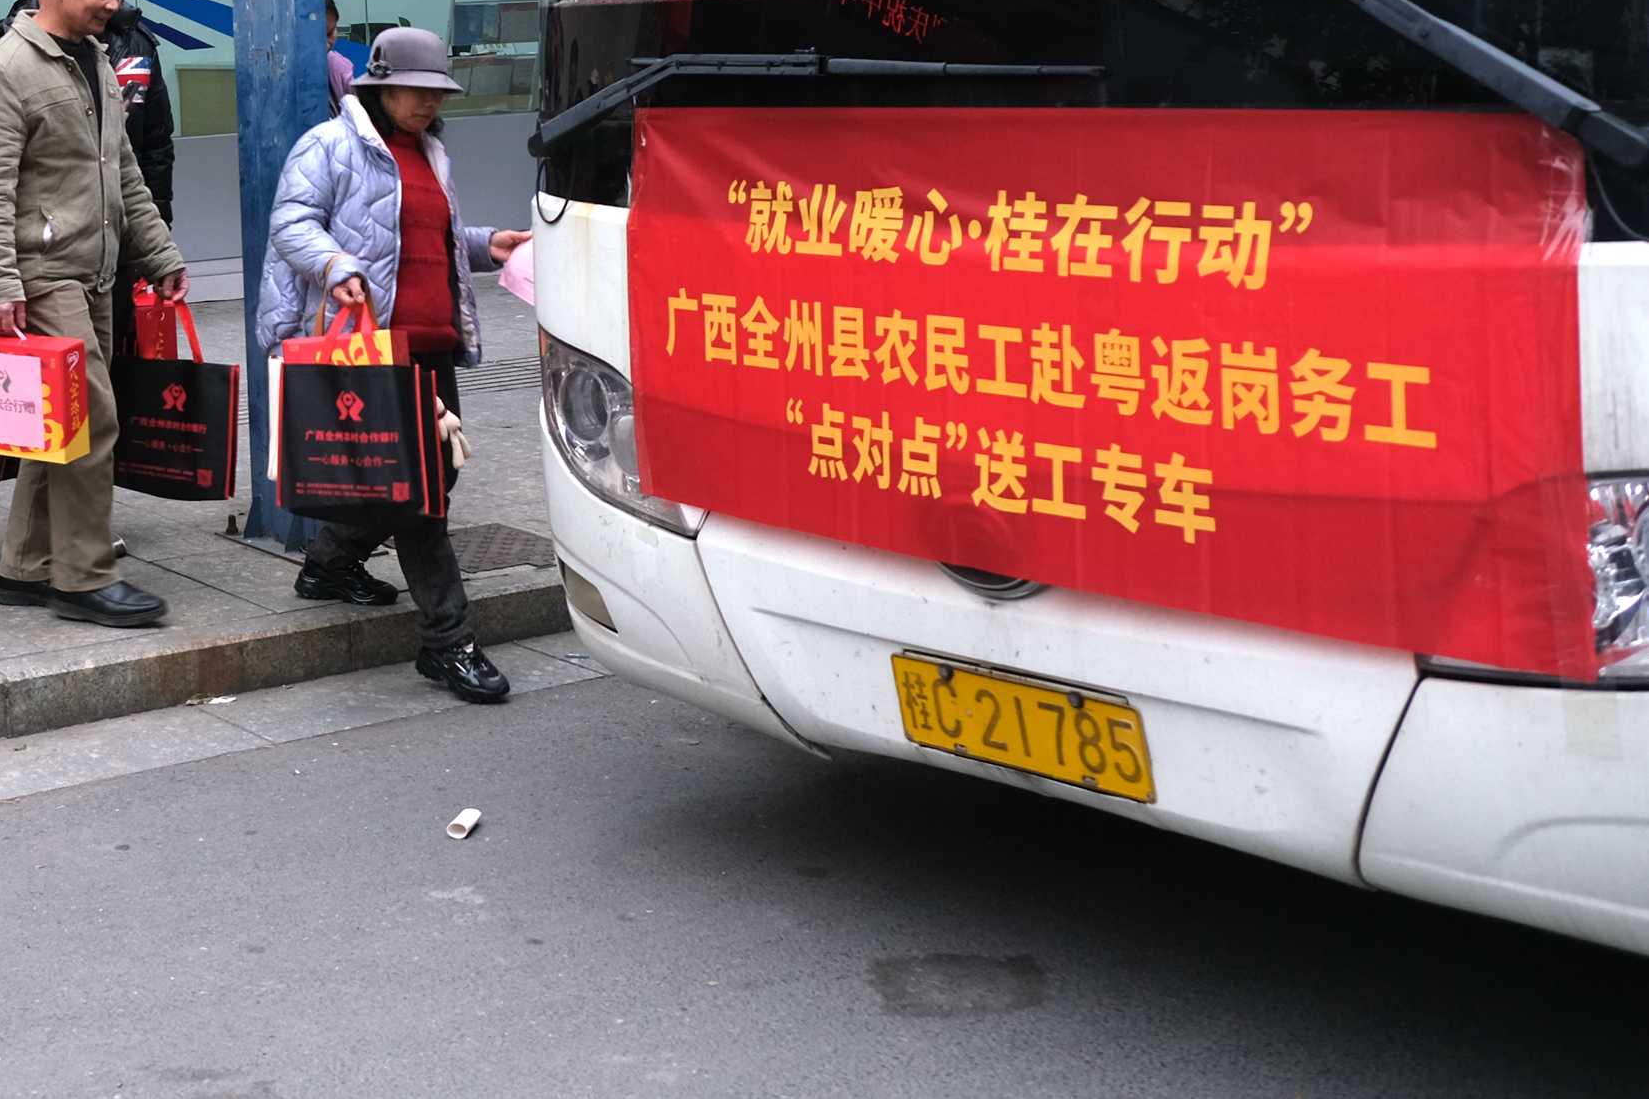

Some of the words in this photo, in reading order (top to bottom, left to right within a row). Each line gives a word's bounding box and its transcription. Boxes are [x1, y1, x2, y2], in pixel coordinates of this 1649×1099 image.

[666, 290, 1437, 449] 广西全州县农民工赴粤返岗务工
[787, 402, 1217, 543] “点对点”送工专车
